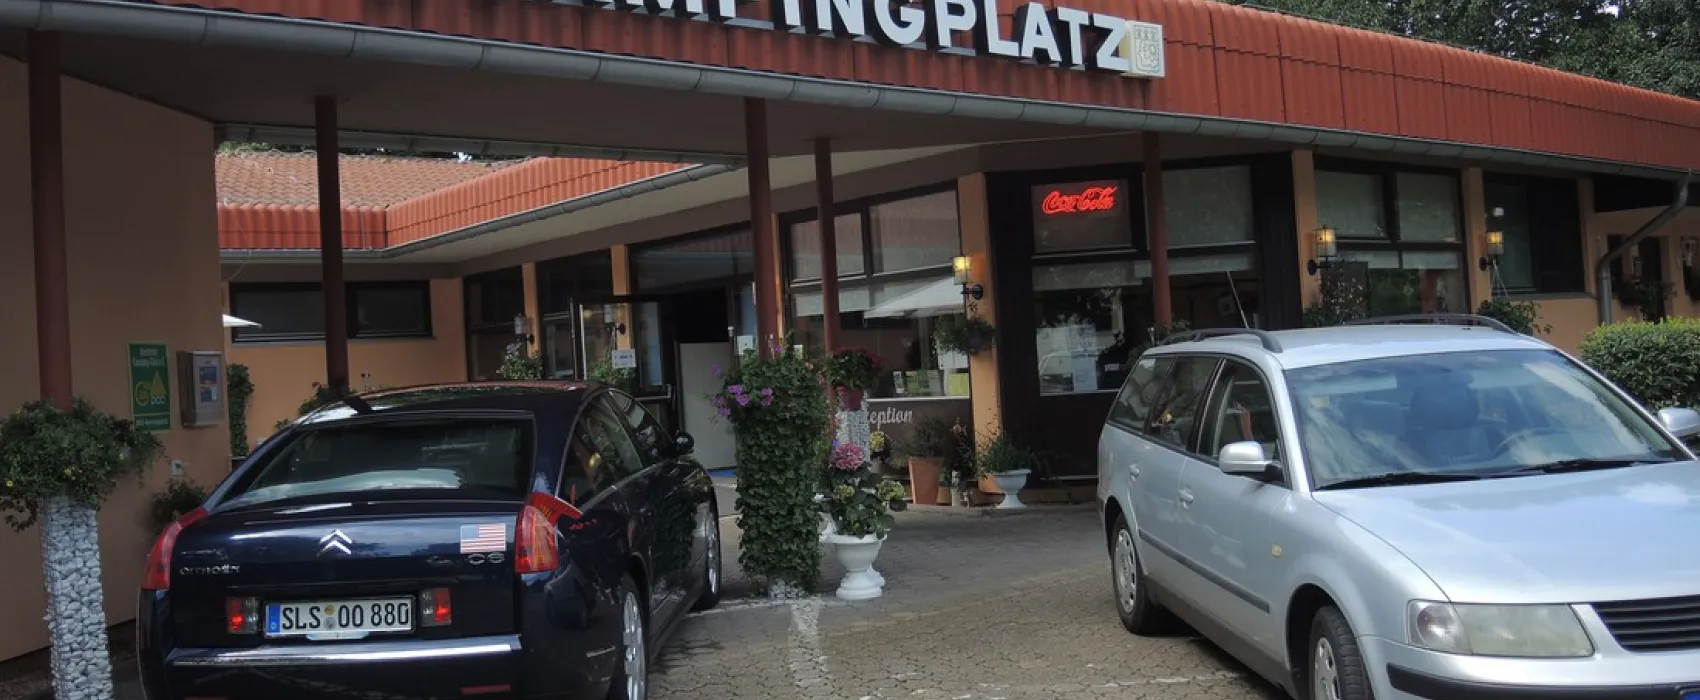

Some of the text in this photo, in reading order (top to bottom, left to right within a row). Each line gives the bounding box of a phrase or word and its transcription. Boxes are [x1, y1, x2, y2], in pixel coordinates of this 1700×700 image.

[868, 406, 913, 431] eption
[282, 606, 321, 630] SLS
[370, 602, 409, 627] 880
